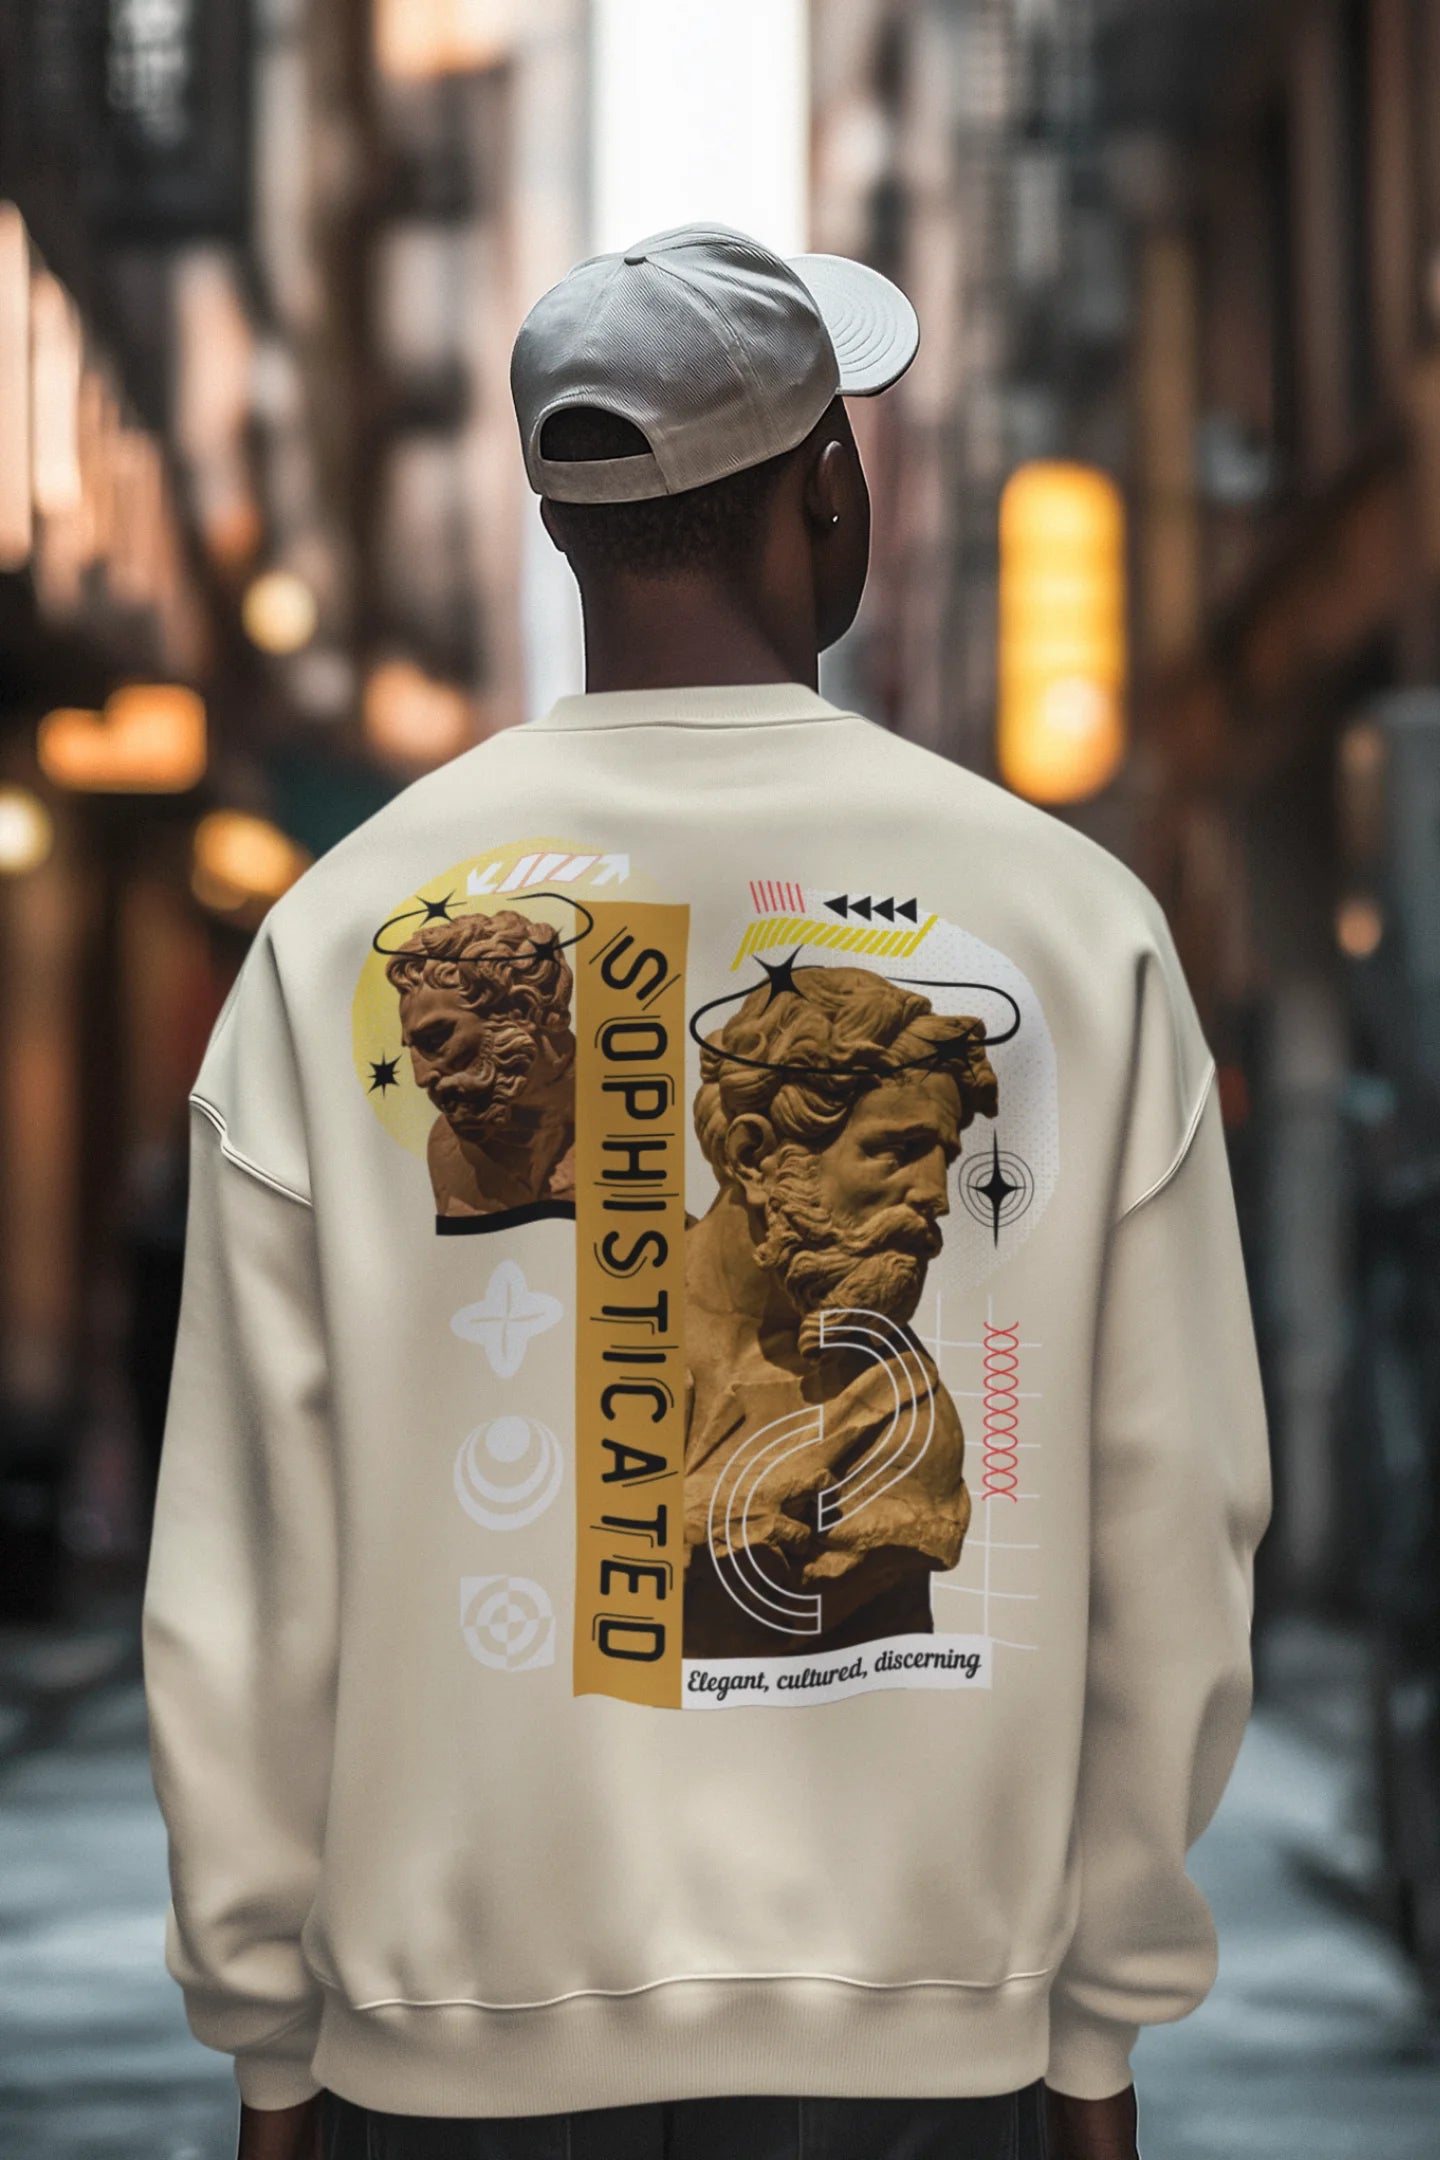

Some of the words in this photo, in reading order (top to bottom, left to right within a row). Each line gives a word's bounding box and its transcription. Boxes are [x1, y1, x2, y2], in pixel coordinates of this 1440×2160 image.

[591, 929, 679, 1663] SOPHISTICATED
[687, 1670, 770, 1701] Elegant,
[776, 1657, 868, 1690] cultured,
[874, 1649, 981, 1679] discerning
